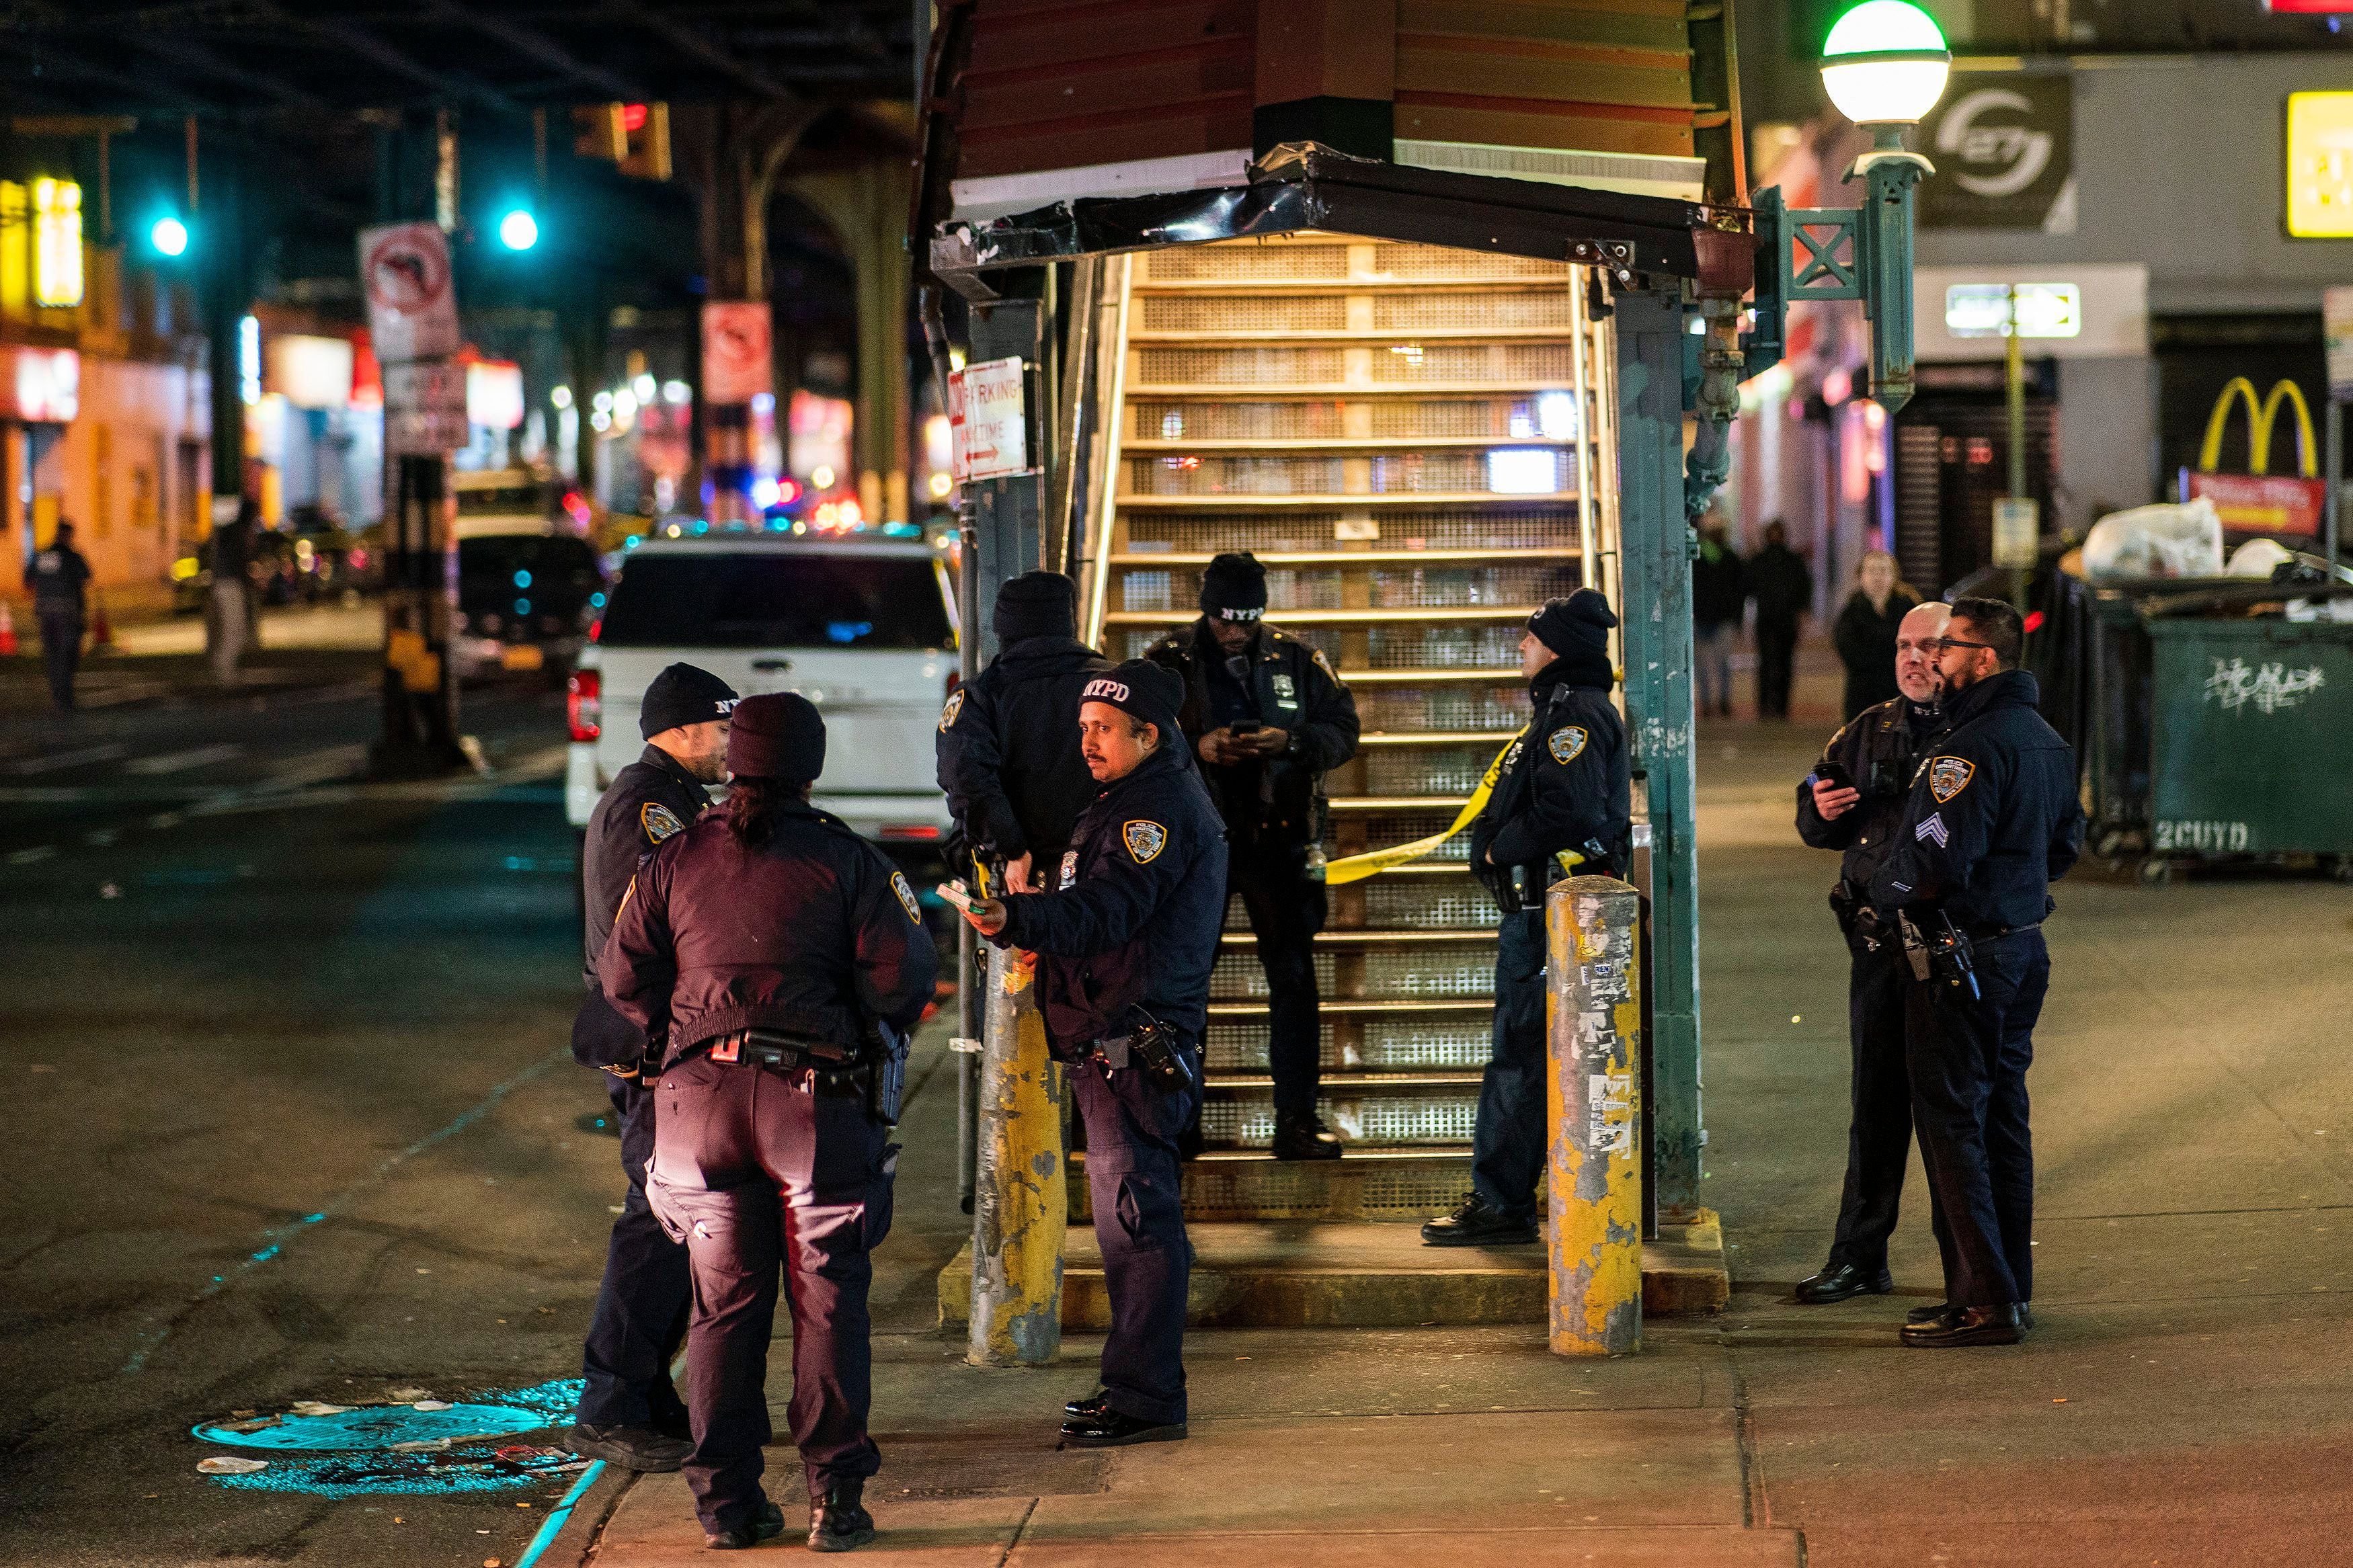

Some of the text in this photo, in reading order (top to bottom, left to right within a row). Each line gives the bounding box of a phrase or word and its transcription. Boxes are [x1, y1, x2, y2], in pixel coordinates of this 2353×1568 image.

[1082, 679, 1129, 702] NYPD
[715, 698, 742, 714] NY
[1135, 823, 1157, 831] POLICE
